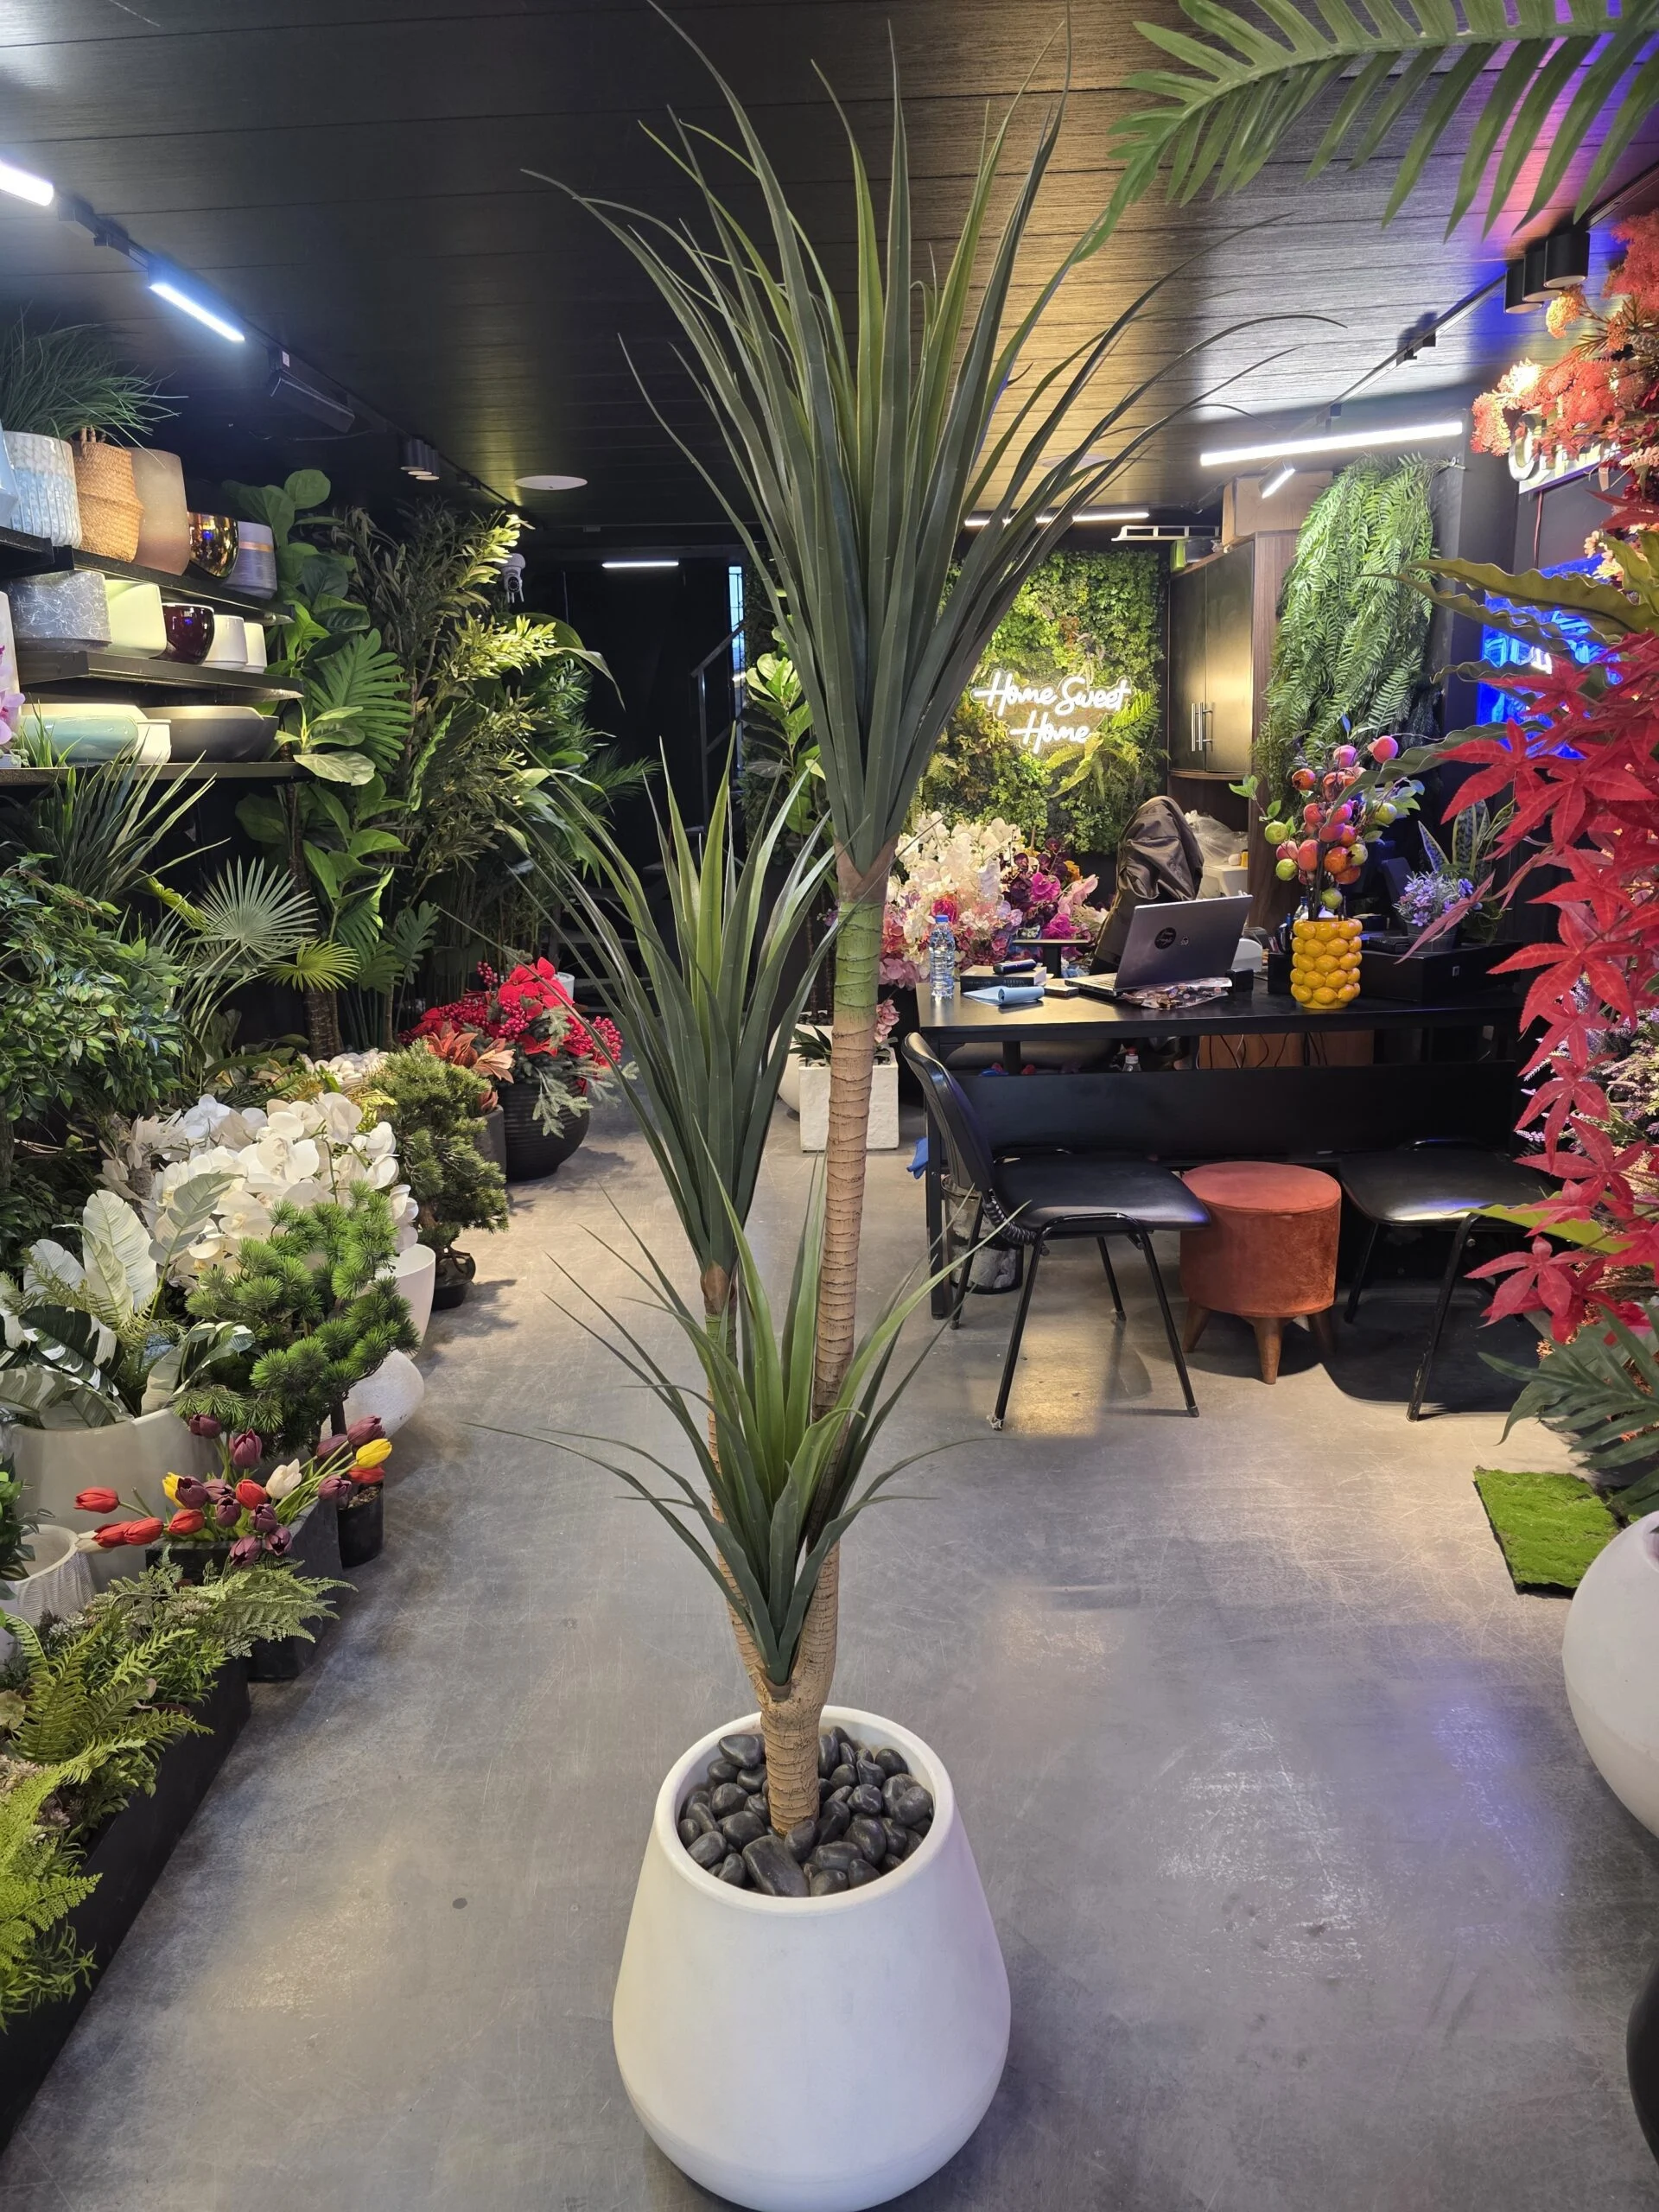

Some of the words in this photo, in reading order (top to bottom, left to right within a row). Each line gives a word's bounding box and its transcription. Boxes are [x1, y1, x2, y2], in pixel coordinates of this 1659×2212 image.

[974, 671, 1058, 717] Home
[1054, 676, 1132, 716] Sweet
[1009, 709, 1090, 755] Home
